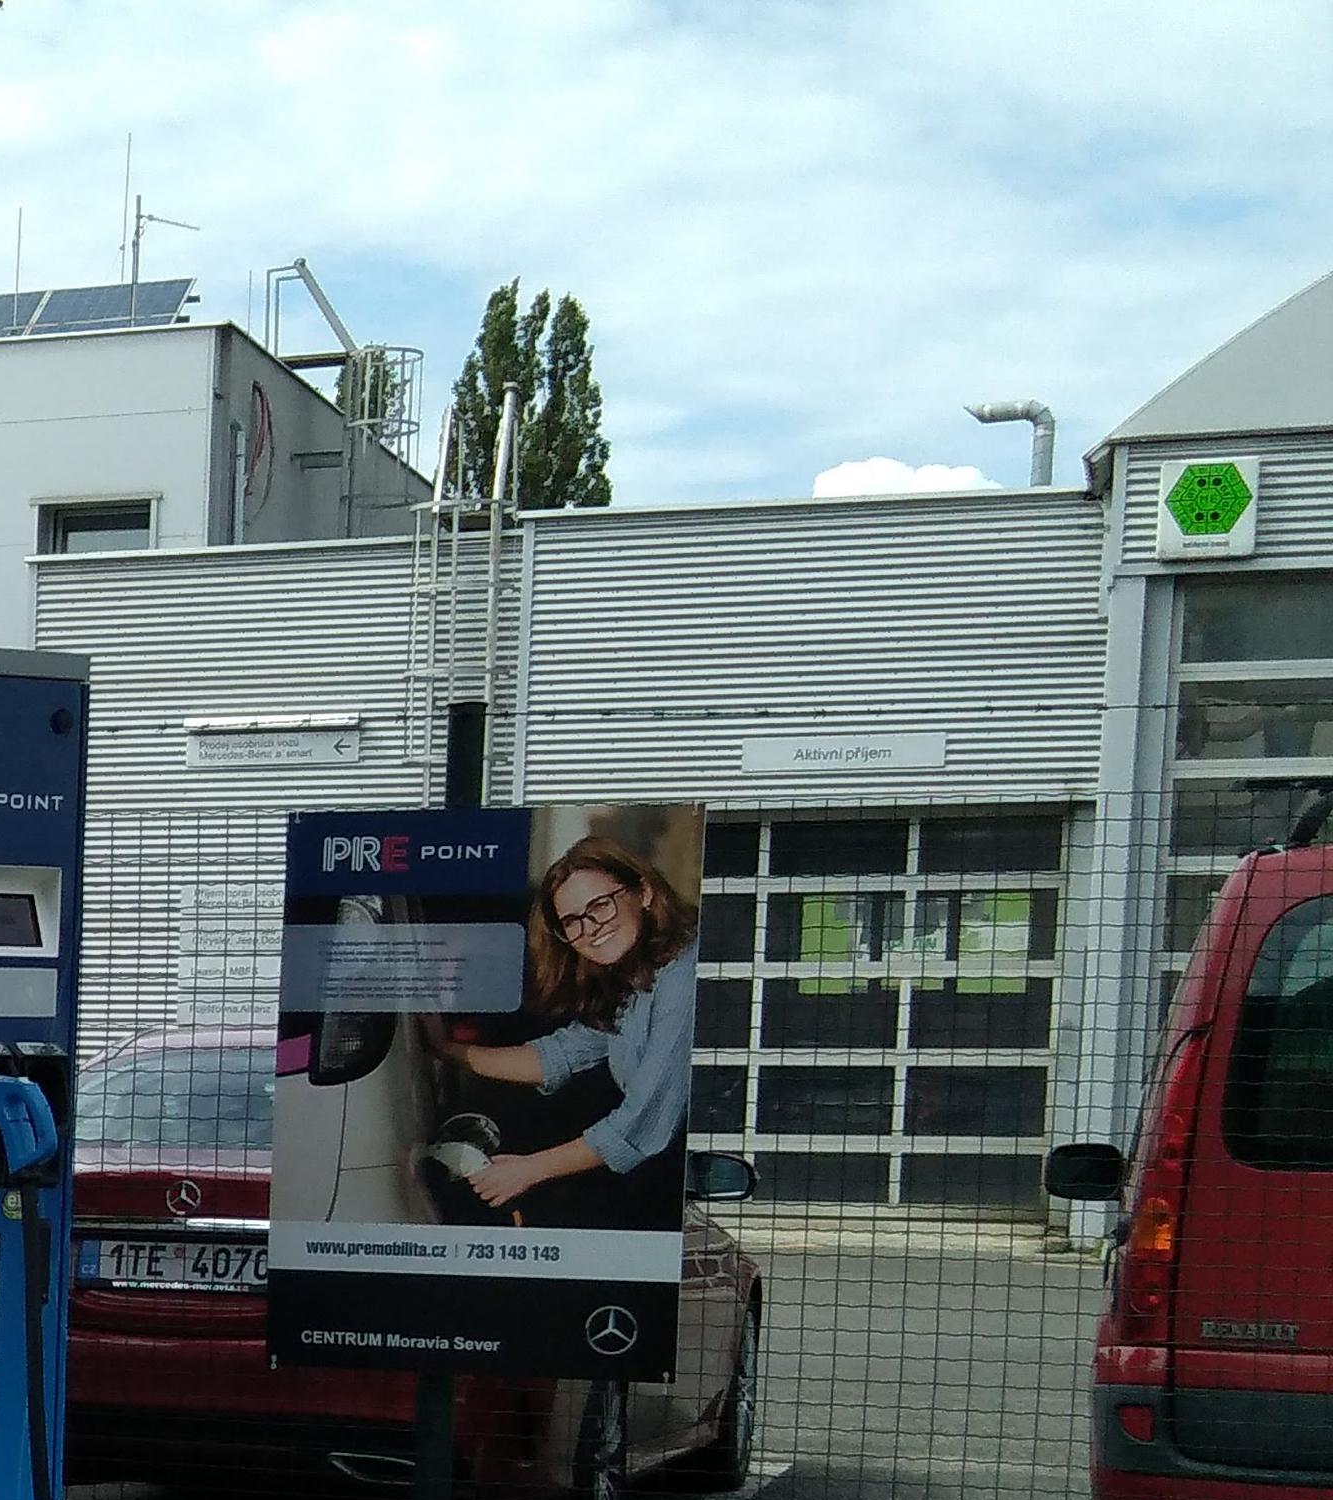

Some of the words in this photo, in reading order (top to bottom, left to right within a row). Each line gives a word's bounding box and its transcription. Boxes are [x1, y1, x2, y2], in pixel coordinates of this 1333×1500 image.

[794, 747, 843, 761] Aktivní
[846, 747, 892, 763] příjem
[323, 836, 410, 873] PRE
[420, 844, 500, 860] POINT
[110, 1244, 167, 1277] 1TE
[306, 1240, 447, 1259] www.premobilita.cz
[466, 1243, 495, 1260] 733
[500, 1244, 527, 1260] 143
[532, 1245, 560, 1262] 143
[301, 1330, 382, 1347] CENTRUM
[386, 1333, 450, 1350] Moravia
[453, 1336, 501, 1352] Sever
